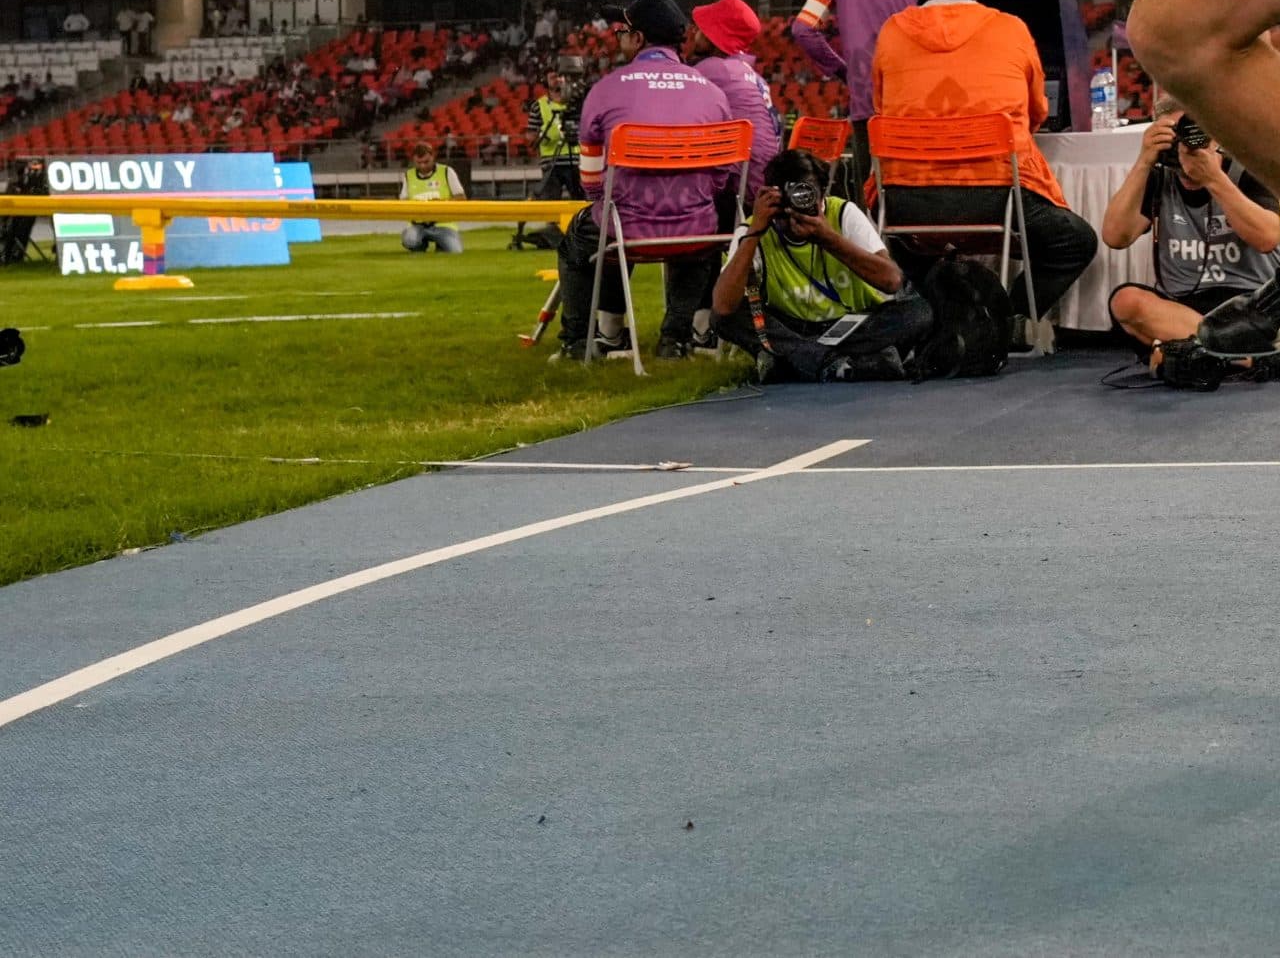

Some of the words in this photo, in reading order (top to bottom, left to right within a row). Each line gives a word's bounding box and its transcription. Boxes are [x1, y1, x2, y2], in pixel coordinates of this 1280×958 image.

[620, 72, 661, 82] NEW
[662, 72, 707, 85] DELHI
[648, 81, 686, 90] 2025
[47, 160, 164, 192] ODILOV
[174, 160, 196, 189] Y
[61, 241, 144, 276] Att.4
